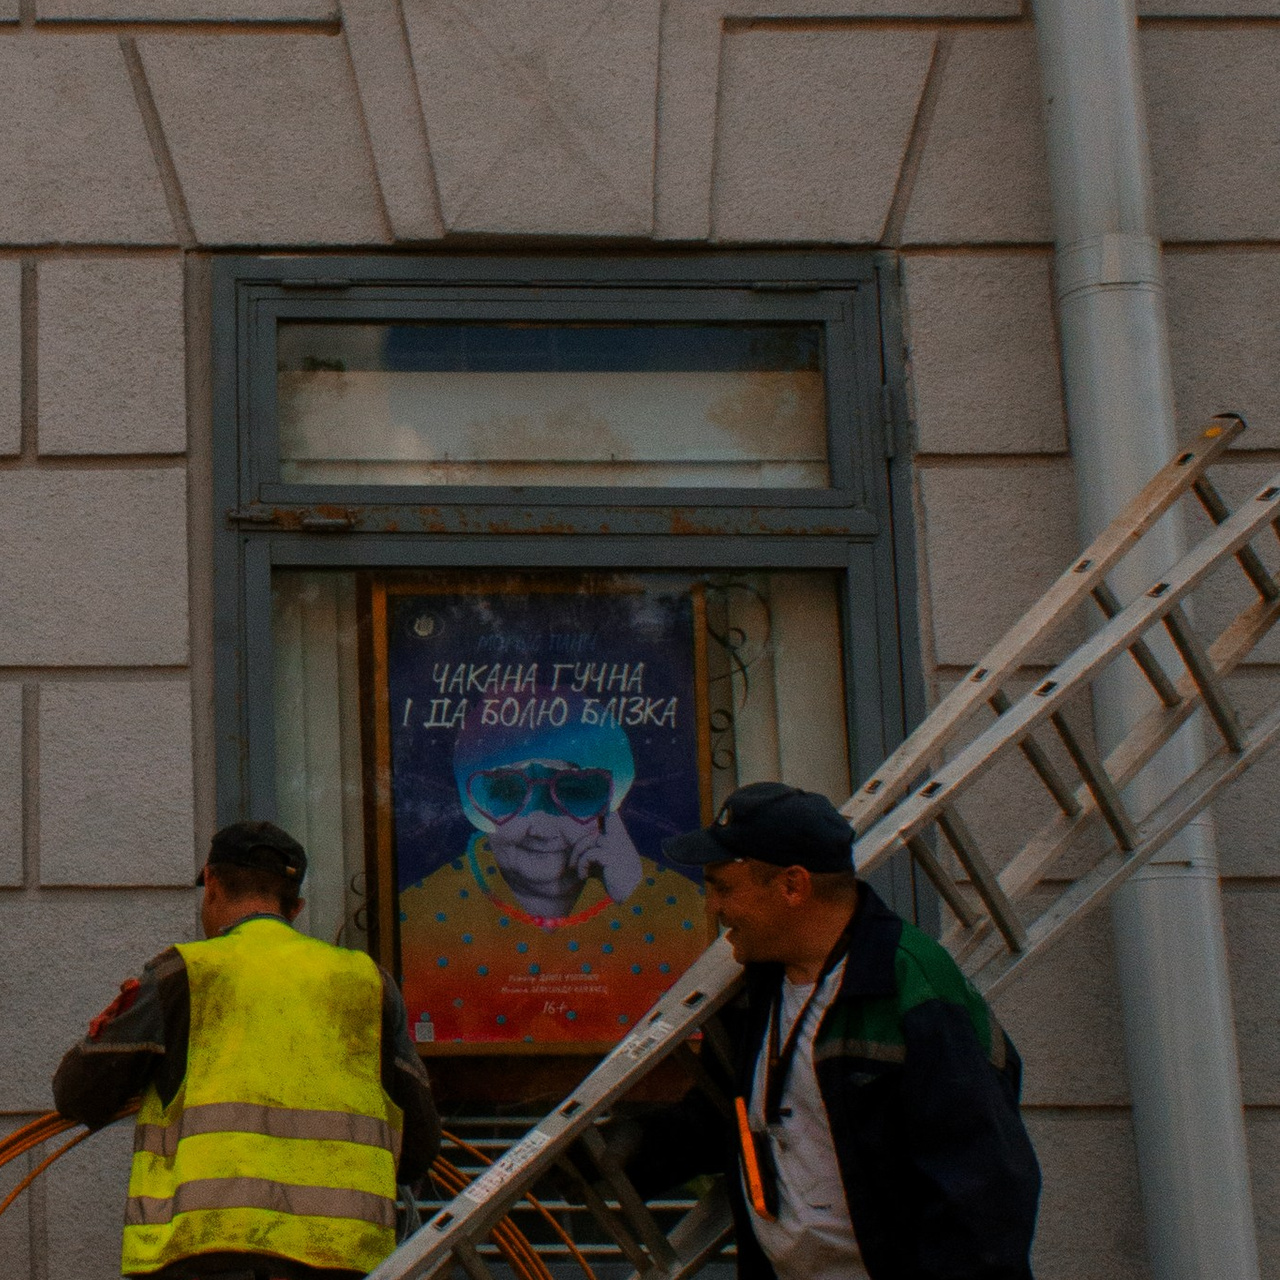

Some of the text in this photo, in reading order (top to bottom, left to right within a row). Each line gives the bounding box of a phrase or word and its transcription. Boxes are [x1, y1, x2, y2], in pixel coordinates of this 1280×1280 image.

[433, 661, 646, 694] ЧАКАНА ГУЧНА
[403, 696, 679, 729] І ДА БОЛЮ БЛІЗКА
[541, 1001, 567, 1015] 16+
